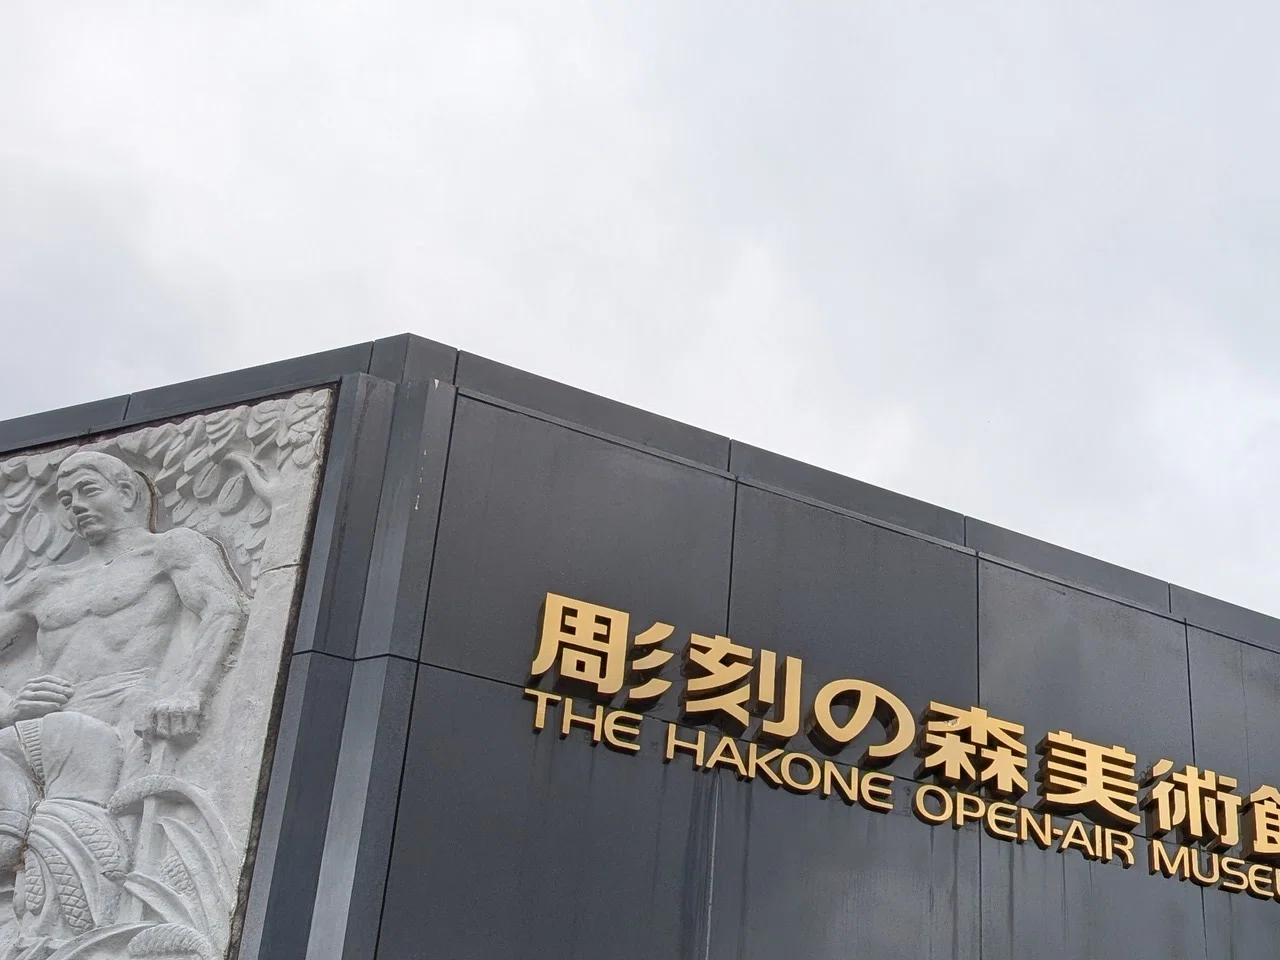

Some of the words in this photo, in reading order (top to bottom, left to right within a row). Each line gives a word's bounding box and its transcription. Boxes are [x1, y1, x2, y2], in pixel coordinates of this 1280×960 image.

[524, 688, 643, 750] THE
[665, 723, 894, 809] HAKONE
[916, 784, 1135, 866] OPEN-AIR
